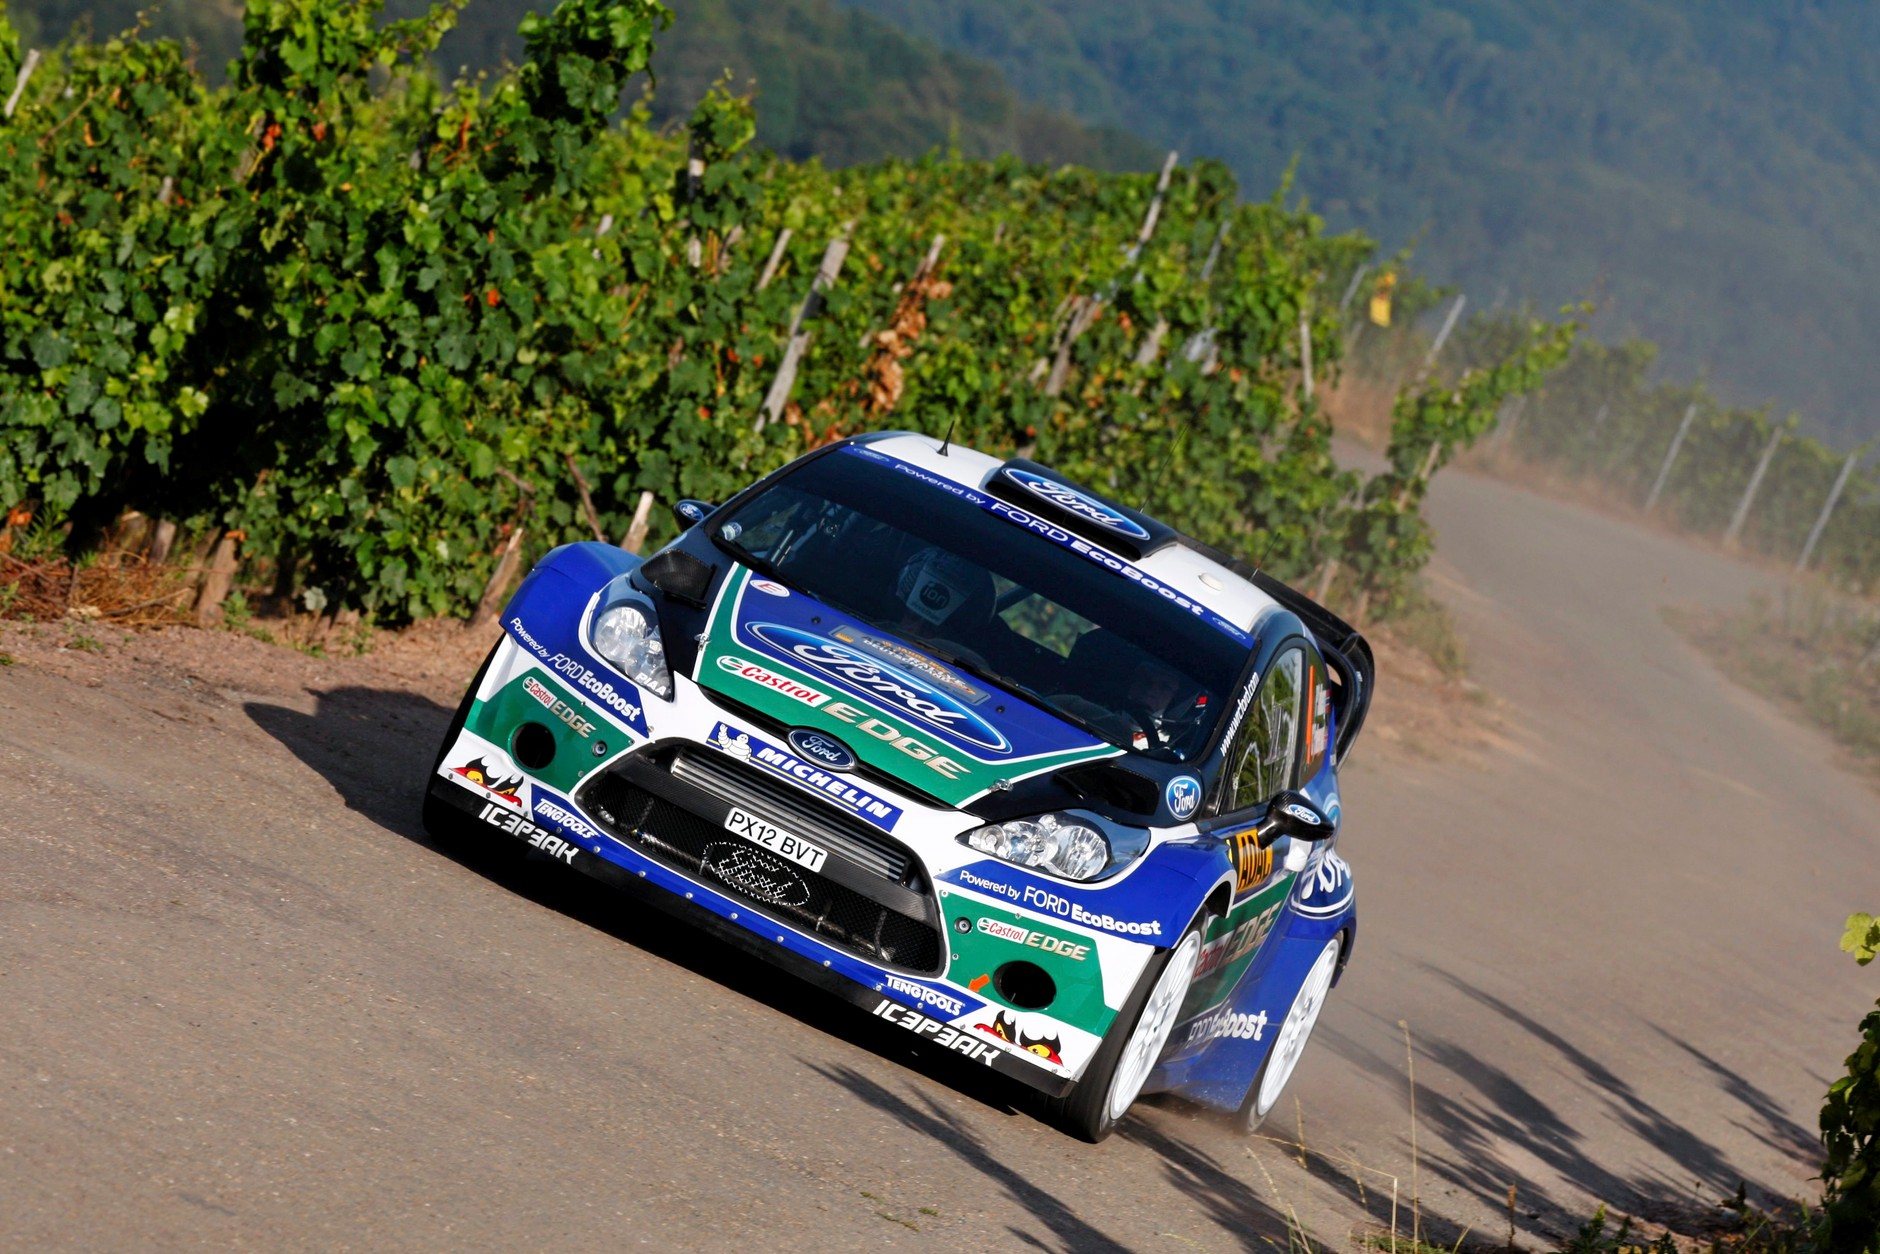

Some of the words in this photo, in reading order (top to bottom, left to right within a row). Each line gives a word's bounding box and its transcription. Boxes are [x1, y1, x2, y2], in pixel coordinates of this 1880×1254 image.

[1027, 478, 1124, 527] Ford
[895, 463, 964, 495] Powered
[966, 493, 986, 504] by
[990, 501, 1069, 542] FORD
[1069, 540, 1204, 616] EcoBoost
[510, 617, 543, 651] Powered
[537, 648, 550, 658] by
[547, 653, 585, 679] FORD
[577, 670, 641, 722] EcoBoost
[635, 673, 667, 695] PIAA
[792, 642, 969, 726] Ford
[528, 682, 555, 707] Castrol
[552, 701, 597, 738] EDGE
[741, 663, 820, 705] Castrol
[820, 701, 972, 780] EDGE
[801, 735, 842, 762] Ford
[756, 747, 892, 819] MICHELIN
[1173, 780, 1196, 812] Ford
[728, 811, 777, 846] PX12
[779, 836, 824, 867] BVT
[1294, 807, 1316, 822] Ford
[959, 870, 1006, 894] Powered
[1006, 884, 1021, 900] by
[1023, 886, 1069, 916] FORD
[1070, 903, 1162, 936] EcoBoost
[988, 922, 1025, 941] Castrol
[1023, 931, 1091, 961] EDGE
